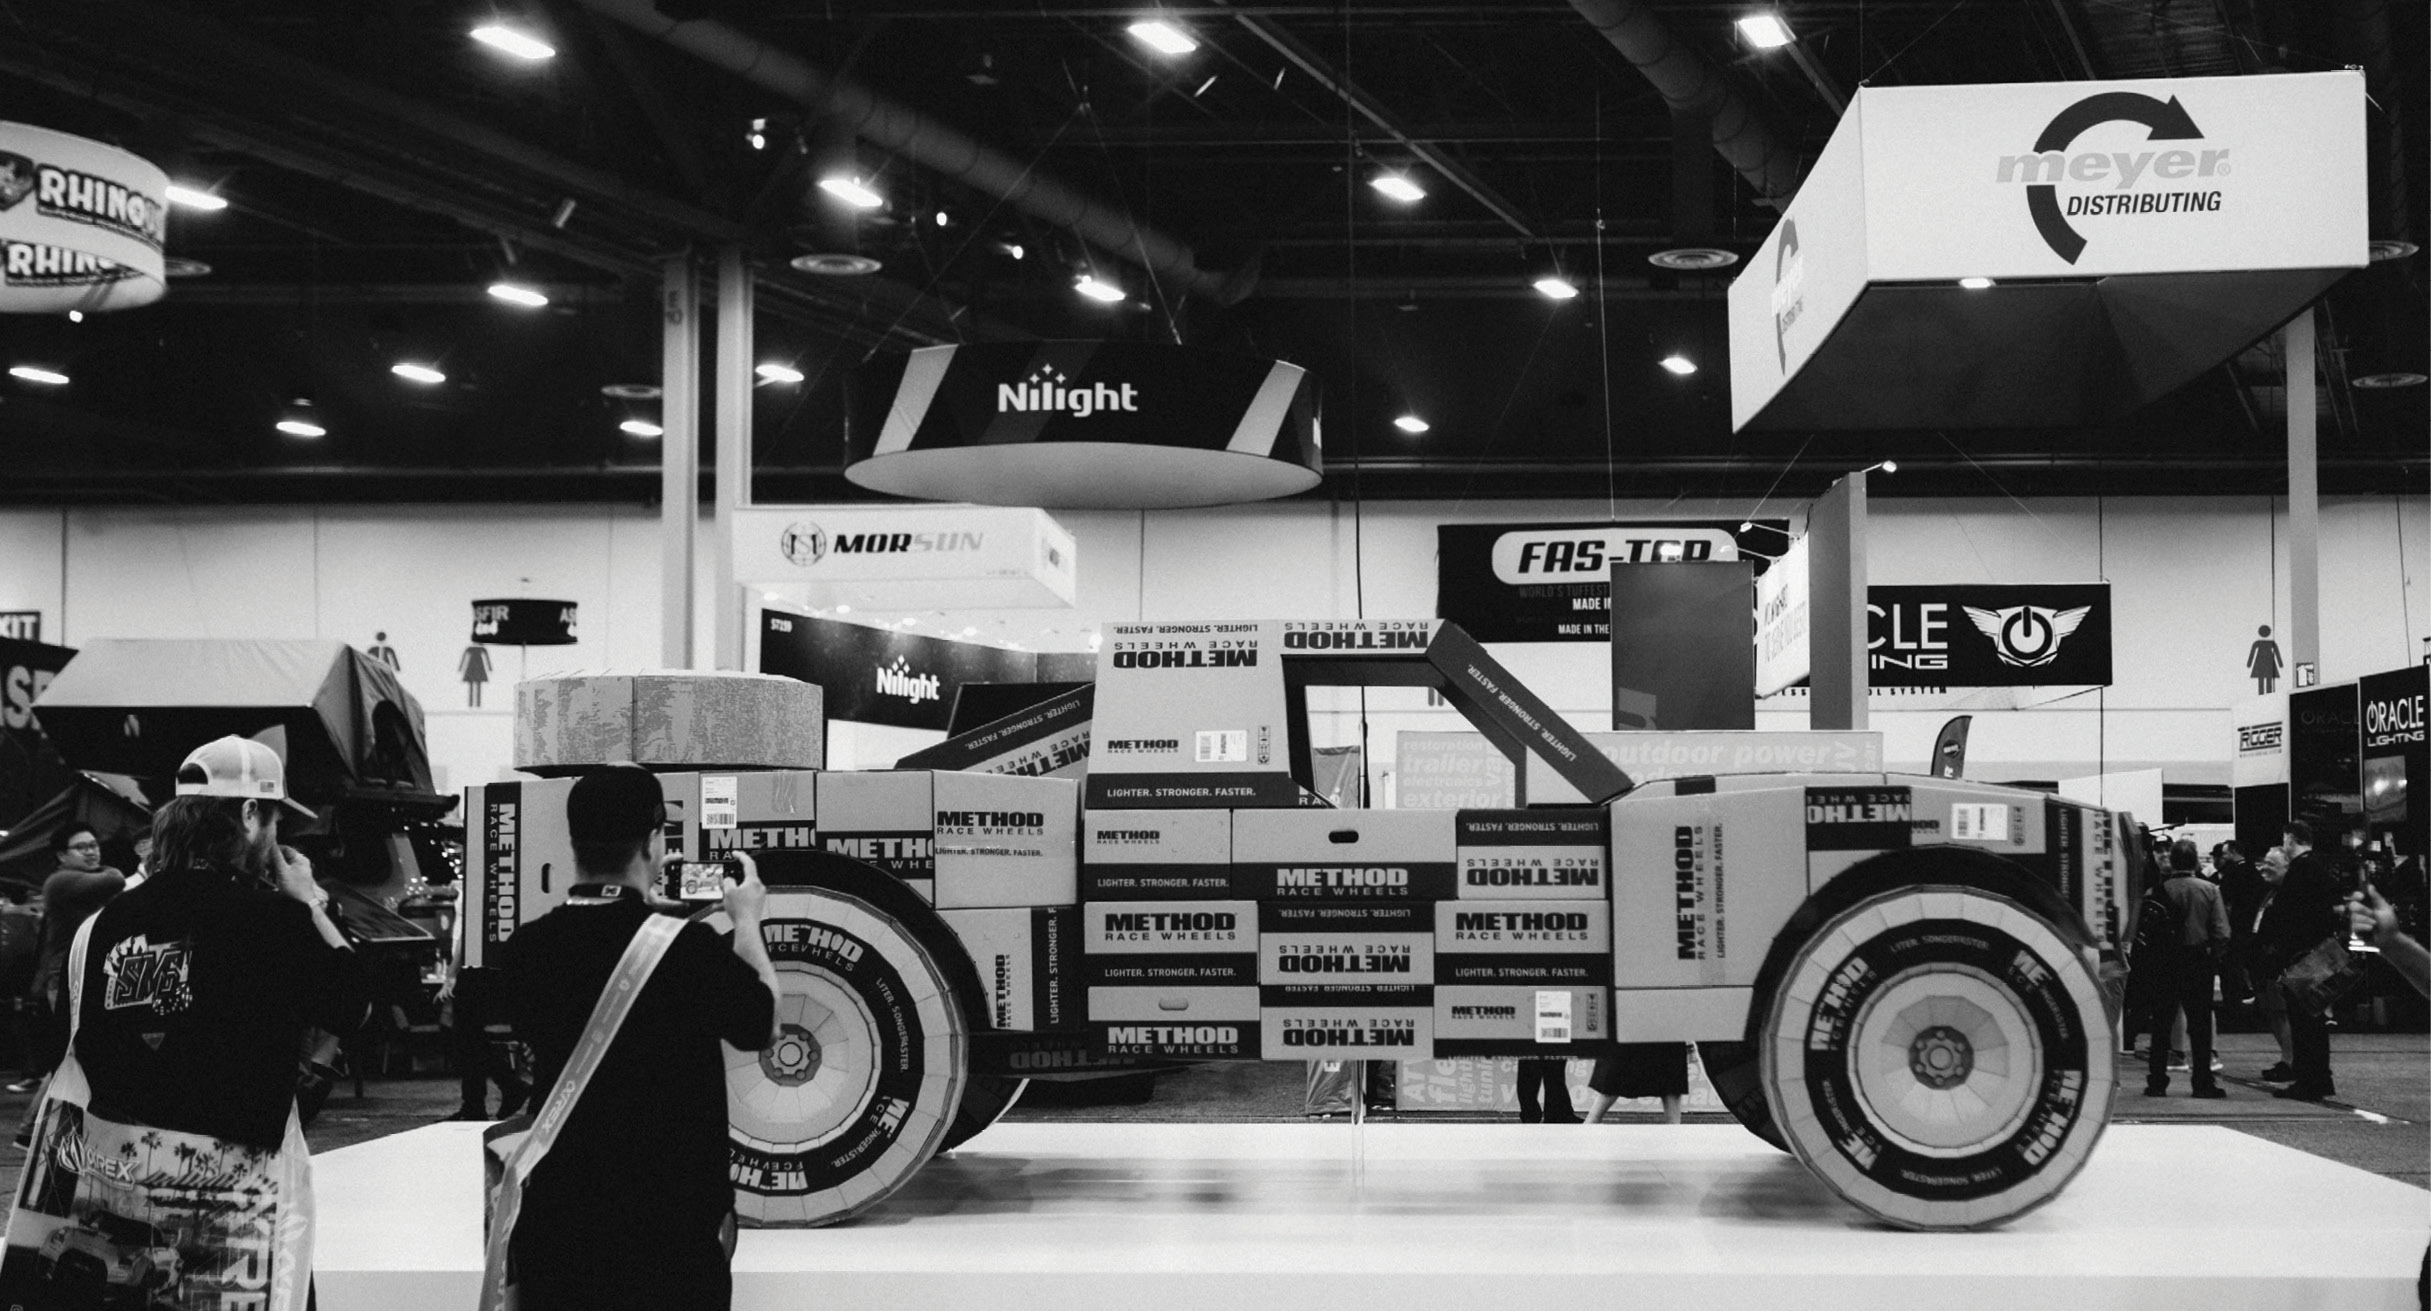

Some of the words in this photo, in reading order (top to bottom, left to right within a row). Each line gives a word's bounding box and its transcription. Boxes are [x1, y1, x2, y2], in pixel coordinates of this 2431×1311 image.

[2067, 190, 2222, 216] DISTRIBUTING
[998, 382, 1138, 417] Nilight
[834, 532, 984, 553] MORSUN
[1572, 598, 1601, 610] MADE
[1114, 626, 1153, 634] FASTER.
[1156, 625, 1211, 634] STRONGER.
[1214, 624, 1258, 632] LIGHTER.
[1284, 622, 1367, 630] WHEELS
[1380, 622, 1428, 630] RACE
[1558, 625, 1580, 634] MADE
[1583, 625, 1592, 634] IN
[1594, 624, 1610, 634] THE
[1114, 642, 1196, 650] WHEELS
[1210, 640, 1258, 648] RACE
[1284, 631, 1428, 650] METHOD
[1113, 650, 1258, 669] METHOD
[876, 665, 940, 704] Nilight
[1468, 664, 1499, 695] FASTER.
[1043, 699, 1081, 719] LIGHTER.
[1498, 690, 1542, 731] STRONGER.
[2366, 695, 2424, 734] ORACLE
[999, 714, 1044, 737] STRONGER.
[964, 732, 998, 750] FASTER.
[1050, 730, 1090, 751] RACE
[1108, 740, 1178, 750] METHOD
[1541, 727, 1576, 762] LIGHTER.
[2367, 730, 2424, 747] LIGHTING
[1403, 754, 1484, 774] trailer
[1735, 744, 1830, 768] power
[1107, 788, 1152, 798] LIGHTER.
[1156, 788, 1212, 797] STRONGER.
[1215, 788, 1256, 796] FASTER.
[1403, 789, 1502, 808] exterior
[937, 811, 1044, 827] METHOD
[1807, 804, 1911, 823] METHO
[489, 804, 498, 852] RACE
[936, 827, 974, 836] RACE
[983, 827, 1044, 836] WHEELS
[1097, 830, 1160, 840] METHOD
[1466, 823, 1503, 831] FASTER.
[1508, 823, 1556, 831] STRONGER.
[1558, 823, 1599, 831] LIGHTER.
[827, 838, 933, 858] METH
[934, 846, 968, 855] LIGHTER.
[970, 848, 1011, 856] STRONGER.
[1014, 849, 1044, 857] FASTER.
[1714, 822, 1723, 863] FASTER.
[1467, 858, 1542, 867] WHEELS
[1554, 858, 1598, 867] RACE
[1695, 826, 1705, 904] WHEELS
[1098, 879, 1138, 888] LIGHTER.
[1140, 879, 1190, 888] STRONGER.
[1193, 879, 1230, 888] FASTER.
[1277, 868, 1408, 886] METHOD
[1466, 868, 1598, 886] METHOD
[1277, 887, 1322, 896] RACE
[1333, 887, 1408, 896] WHEELS
[1675, 826, 1696, 960] METHOD
[1715, 864, 1724, 914] STRONGER.
[489, 862, 499, 942] WHEELS
[1105, 913, 1236, 931] METHOD
[1278, 909, 1315, 918] FASTER.
[1319, 909, 1368, 918] STRONGER.
[1370, 909, 1411, 918] LIGHTER.
[1456, 913, 1588, 931] METHOD
[1049, 914, 1058, 974] STRONGER.
[1105, 932, 1150, 941] RACE
[1162, 932, 1236, 941] WHEELS
[1456, 932, 1501, 940] RACE
[1513, 932, 1588, 940] WHEELS
[1698, 914, 1706, 960] RACE
[1717, 914, 1726, 958] LIGHTER.
[1279, 945, 1354, 954] WHEELS
[1365, 945, 1410, 954] RACE
[1105, 968, 1145, 978] LIGHTER.
[1148, 968, 1198, 977] STRONGER.
[1200, 968, 1237, 976] FASTER.
[1279, 955, 1410, 973] METHOD
[1456, 968, 1496, 977] LIGHTER.
[1498, 968, 1550, 977] STRONGER.
[1552, 968, 1588, 977] FASTER.
[995, 954, 1008, 1028] METHOD
[1050, 978, 1059, 1024] LIGHTER.
[1452, 1006, 1516, 1016] METHOD
[1284, 1019, 1358, 1028] WHEELS
[1369, 1019, 1414, 1028] RACE
[1108, 1026, 1238, 1045] METHOD
[1283, 1028, 1414, 1046] METHOD
[1108, 1045, 1152, 1054] RACE
[1164, 1045, 1238, 1054] WHEELS
